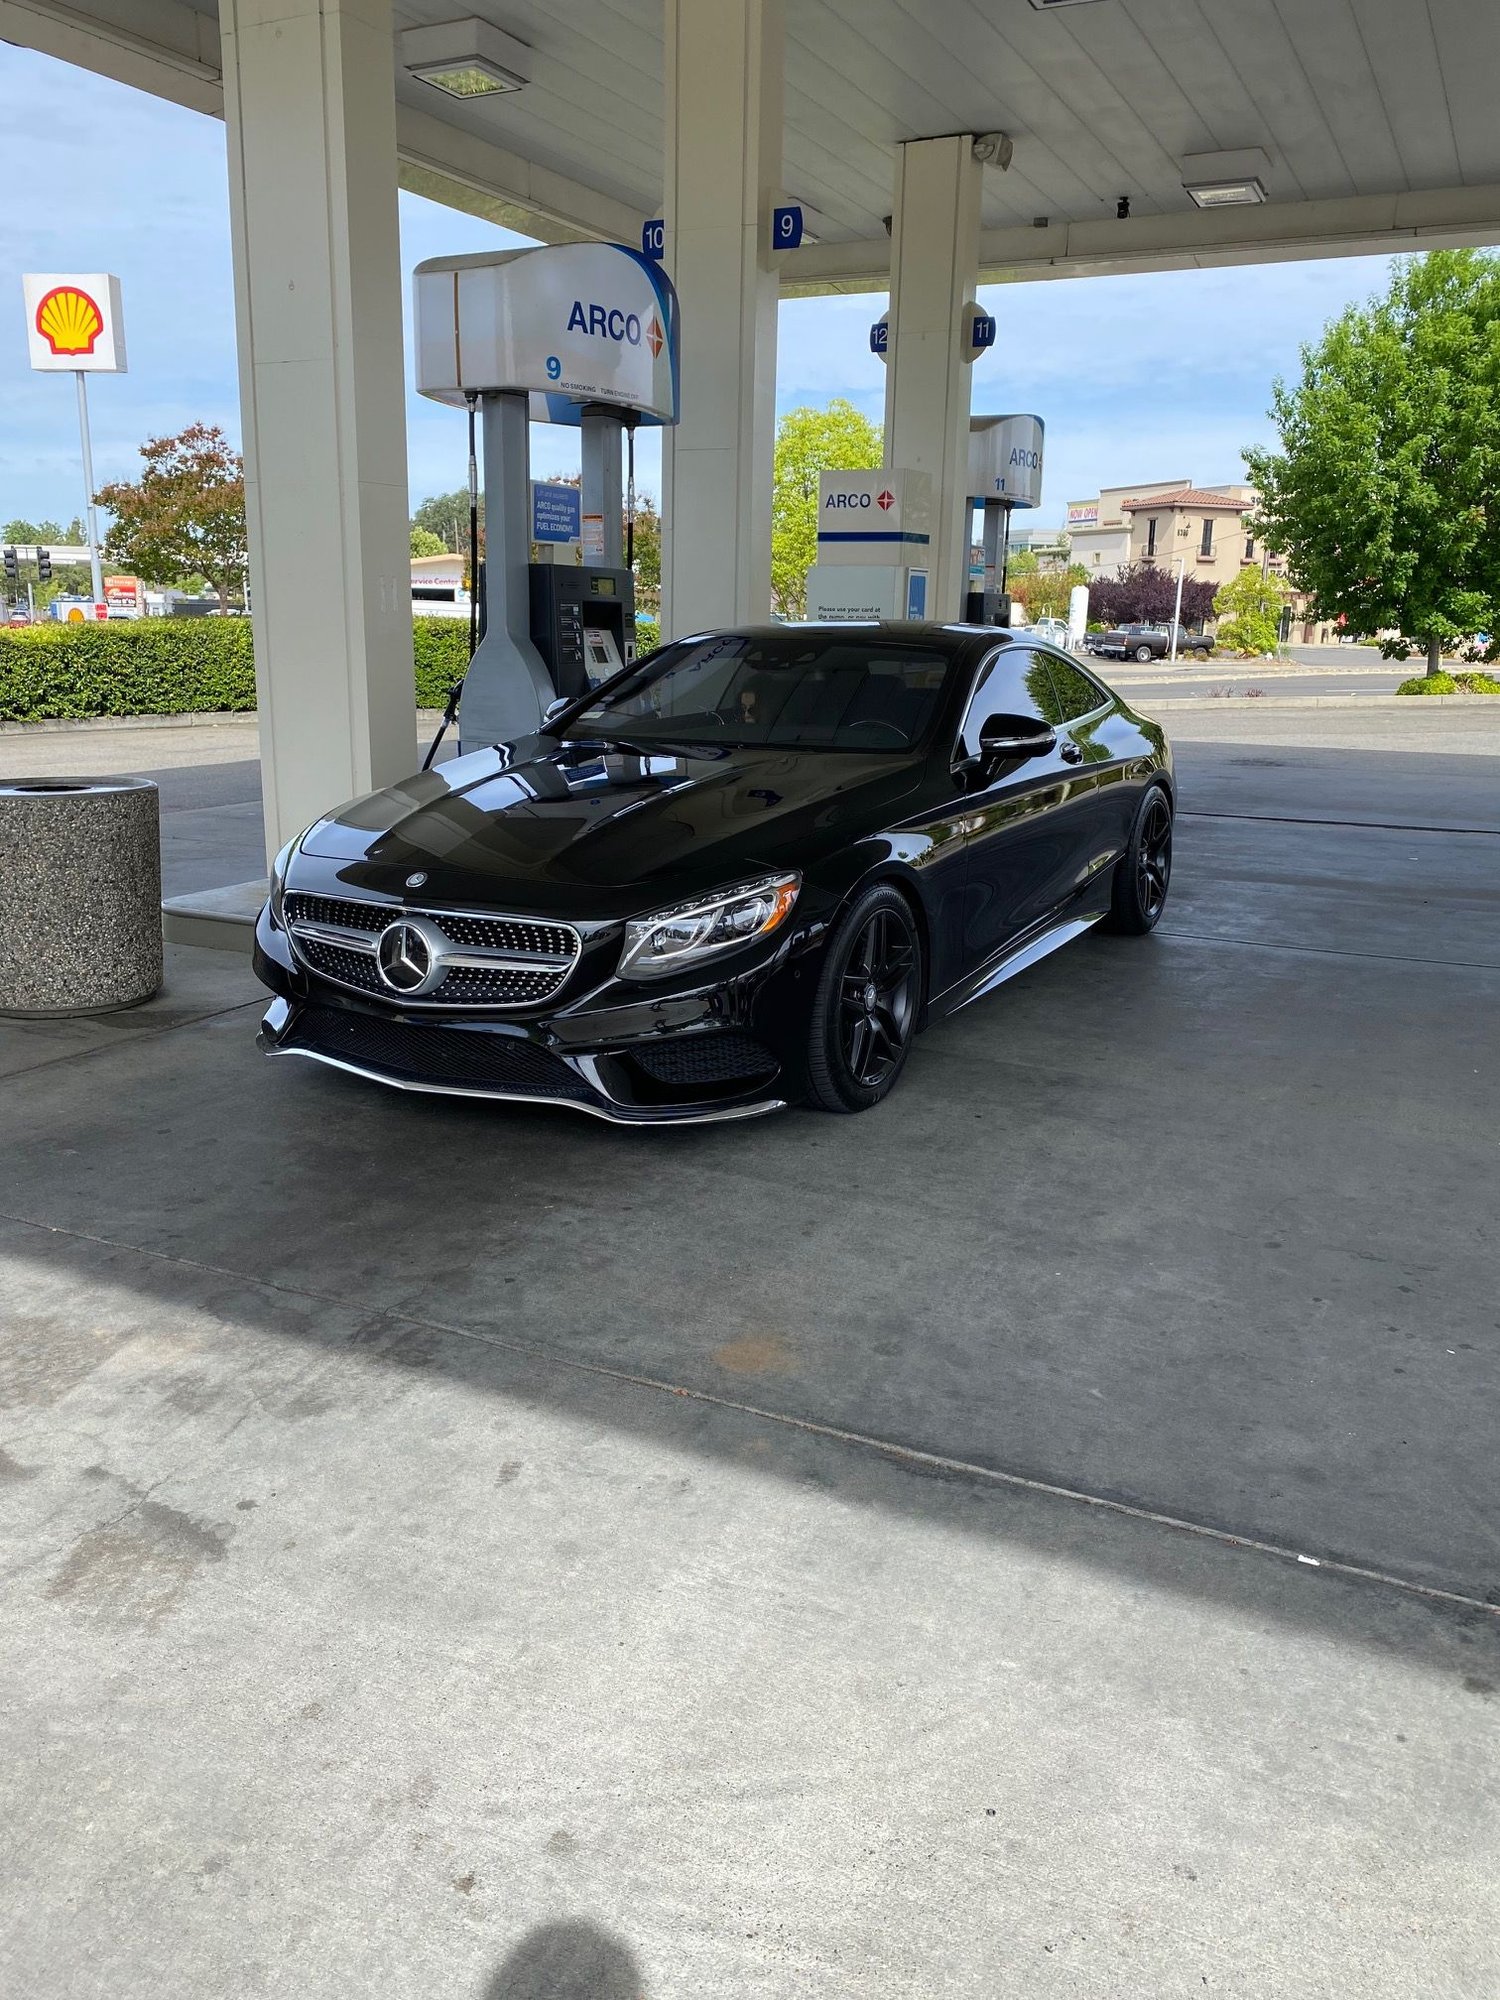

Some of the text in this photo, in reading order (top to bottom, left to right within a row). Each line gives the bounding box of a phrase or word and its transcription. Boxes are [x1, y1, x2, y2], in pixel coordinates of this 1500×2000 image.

[781, 214, 794, 238] 9
[645, 226, 665, 249] 10
[567, 300, 641, 345] ARCO
[976, 321, 990, 338] 11
[872, 327, 888, 345] 12
[546, 355, 561, 380] 9
[560, 381, 570, 389] NO
[570, 383, 597, 393] SMOKING
[1009, 447, 1039, 469] ARCO
[994, 477, 1006, 491] 11
[825, 493, 871, 509] ARCO
[1070, 506, 1098, 520] NOW OPEN
[536, 521, 550, 531] FUEL
[434, 577, 459, 585] Center
